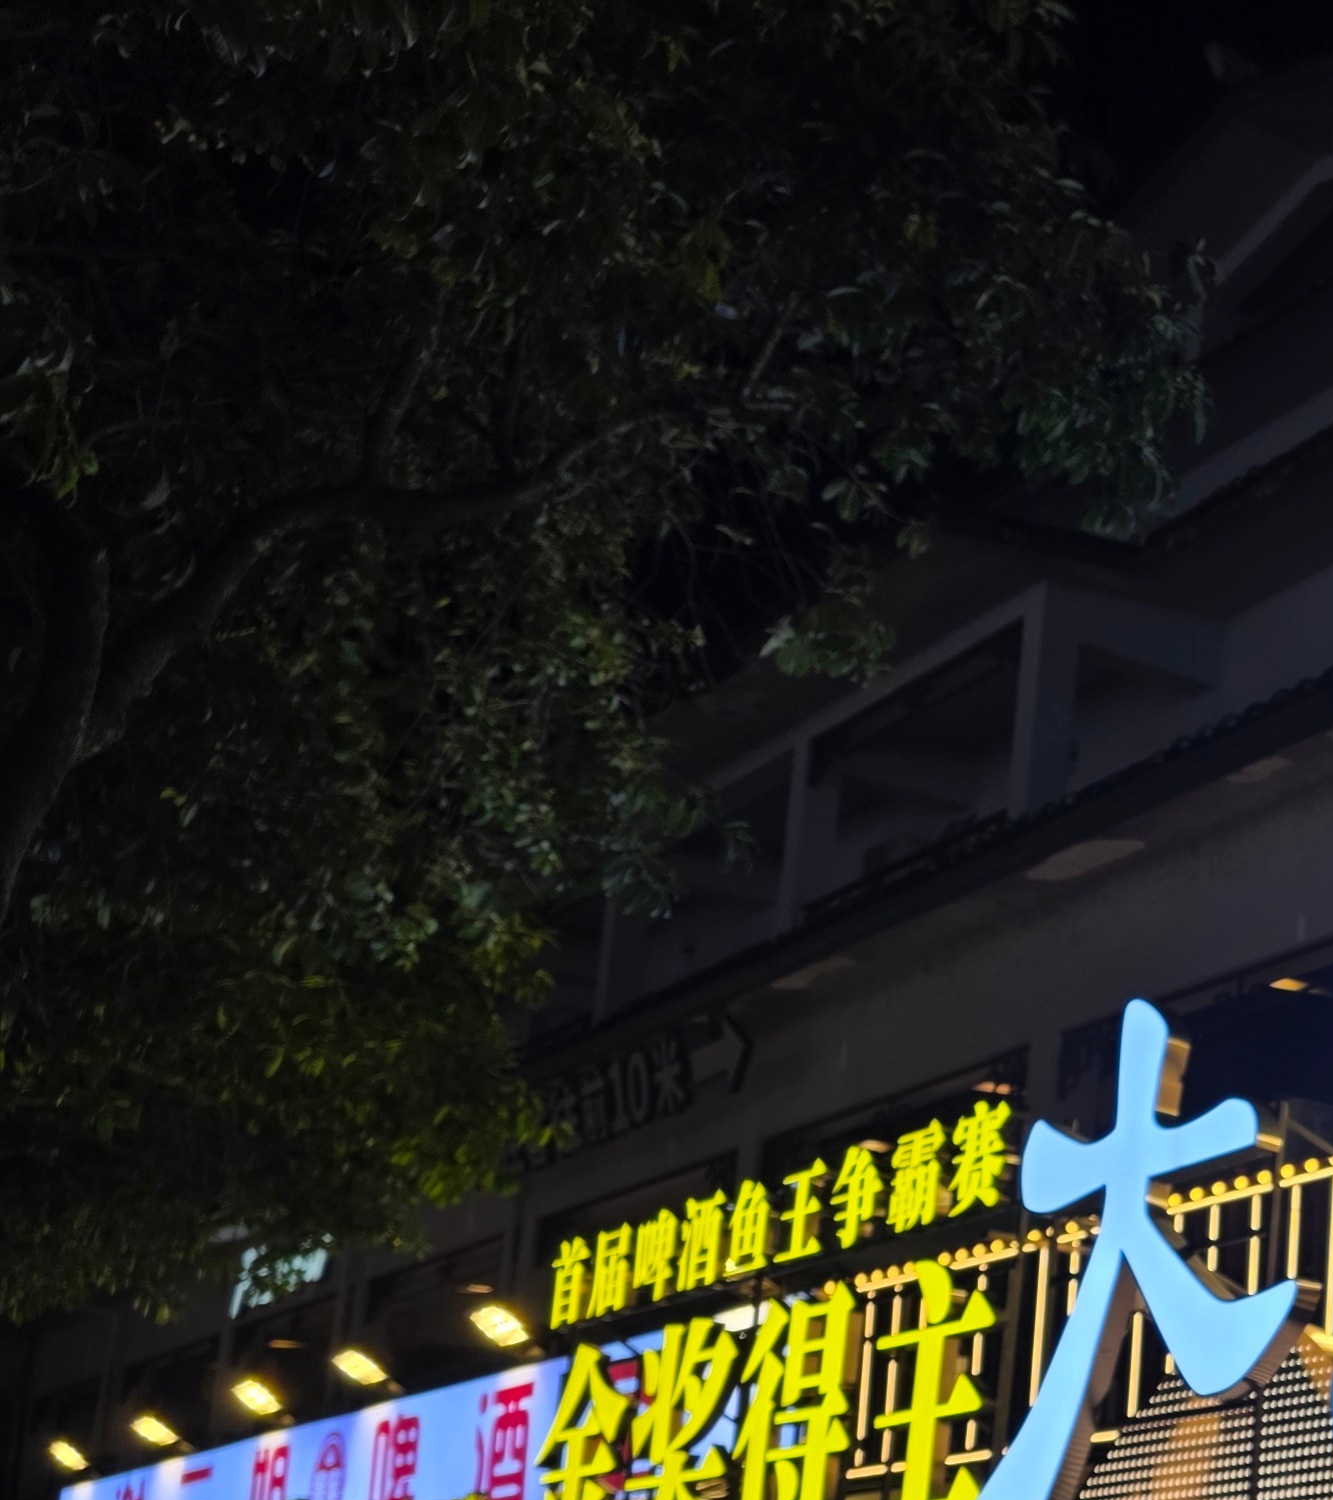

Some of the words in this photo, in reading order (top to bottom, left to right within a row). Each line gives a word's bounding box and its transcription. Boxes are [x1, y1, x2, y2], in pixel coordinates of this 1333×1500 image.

[549, 1100, 1011, 1329] 首届啤酒鱼王争霸赛
